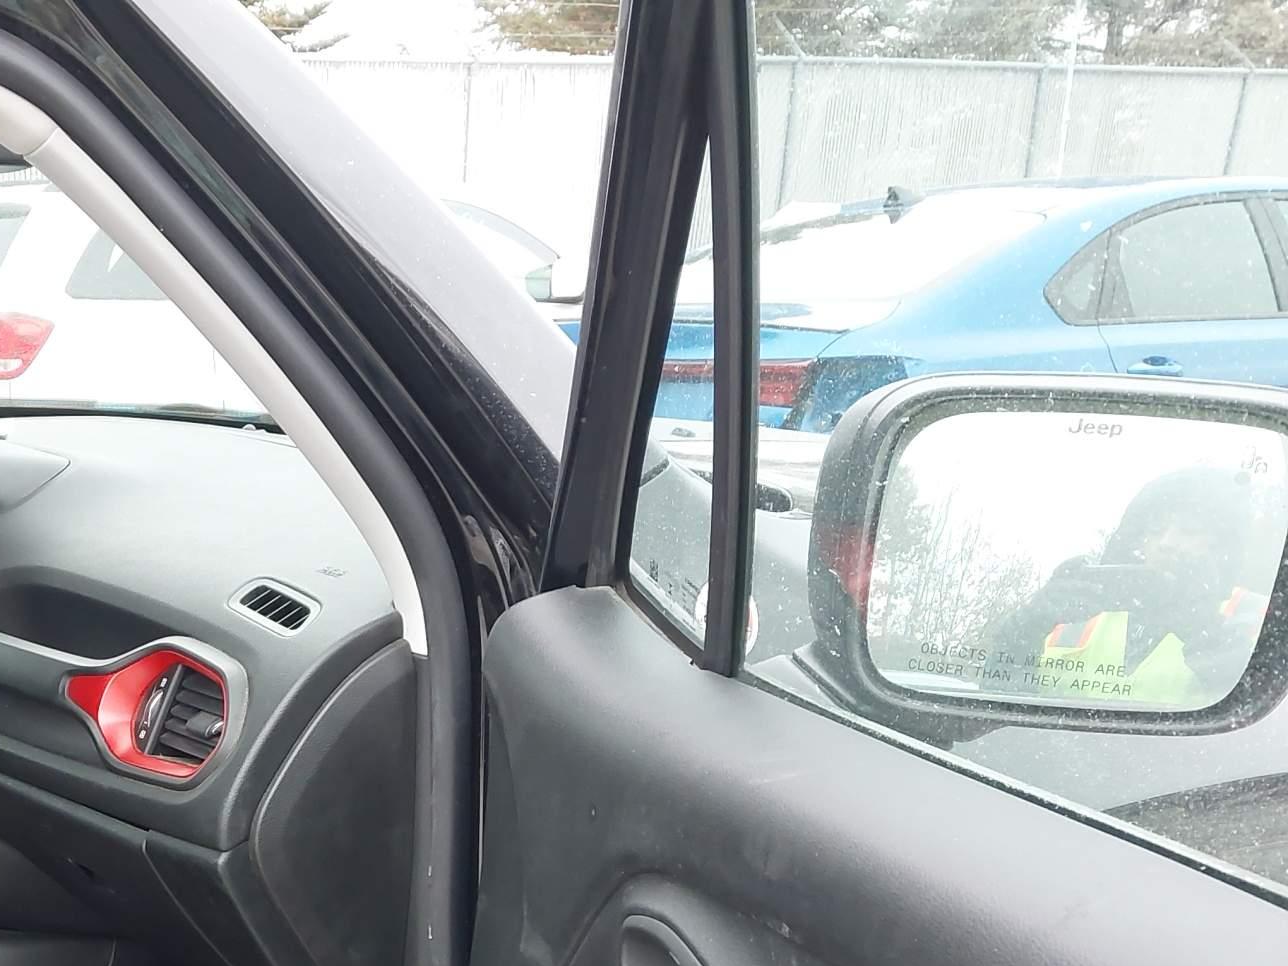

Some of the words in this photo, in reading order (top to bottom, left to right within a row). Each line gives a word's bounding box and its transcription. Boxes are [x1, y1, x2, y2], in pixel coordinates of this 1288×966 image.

[1068, 418, 1123, 438] Jeep
[907, 658, 963, 676] CLOSER
[974, 667, 1011, 682] THAN
[1023, 672, 1061, 688] THEY
[1070, 680, 1132, 696] APPEAR
[920, 641, 987, 661] OBJECTS
[998, 652, 1015, 664] IN
[1024, 656, 1085, 673] MIRROR
[1094, 664, 1126, 678] ARE
